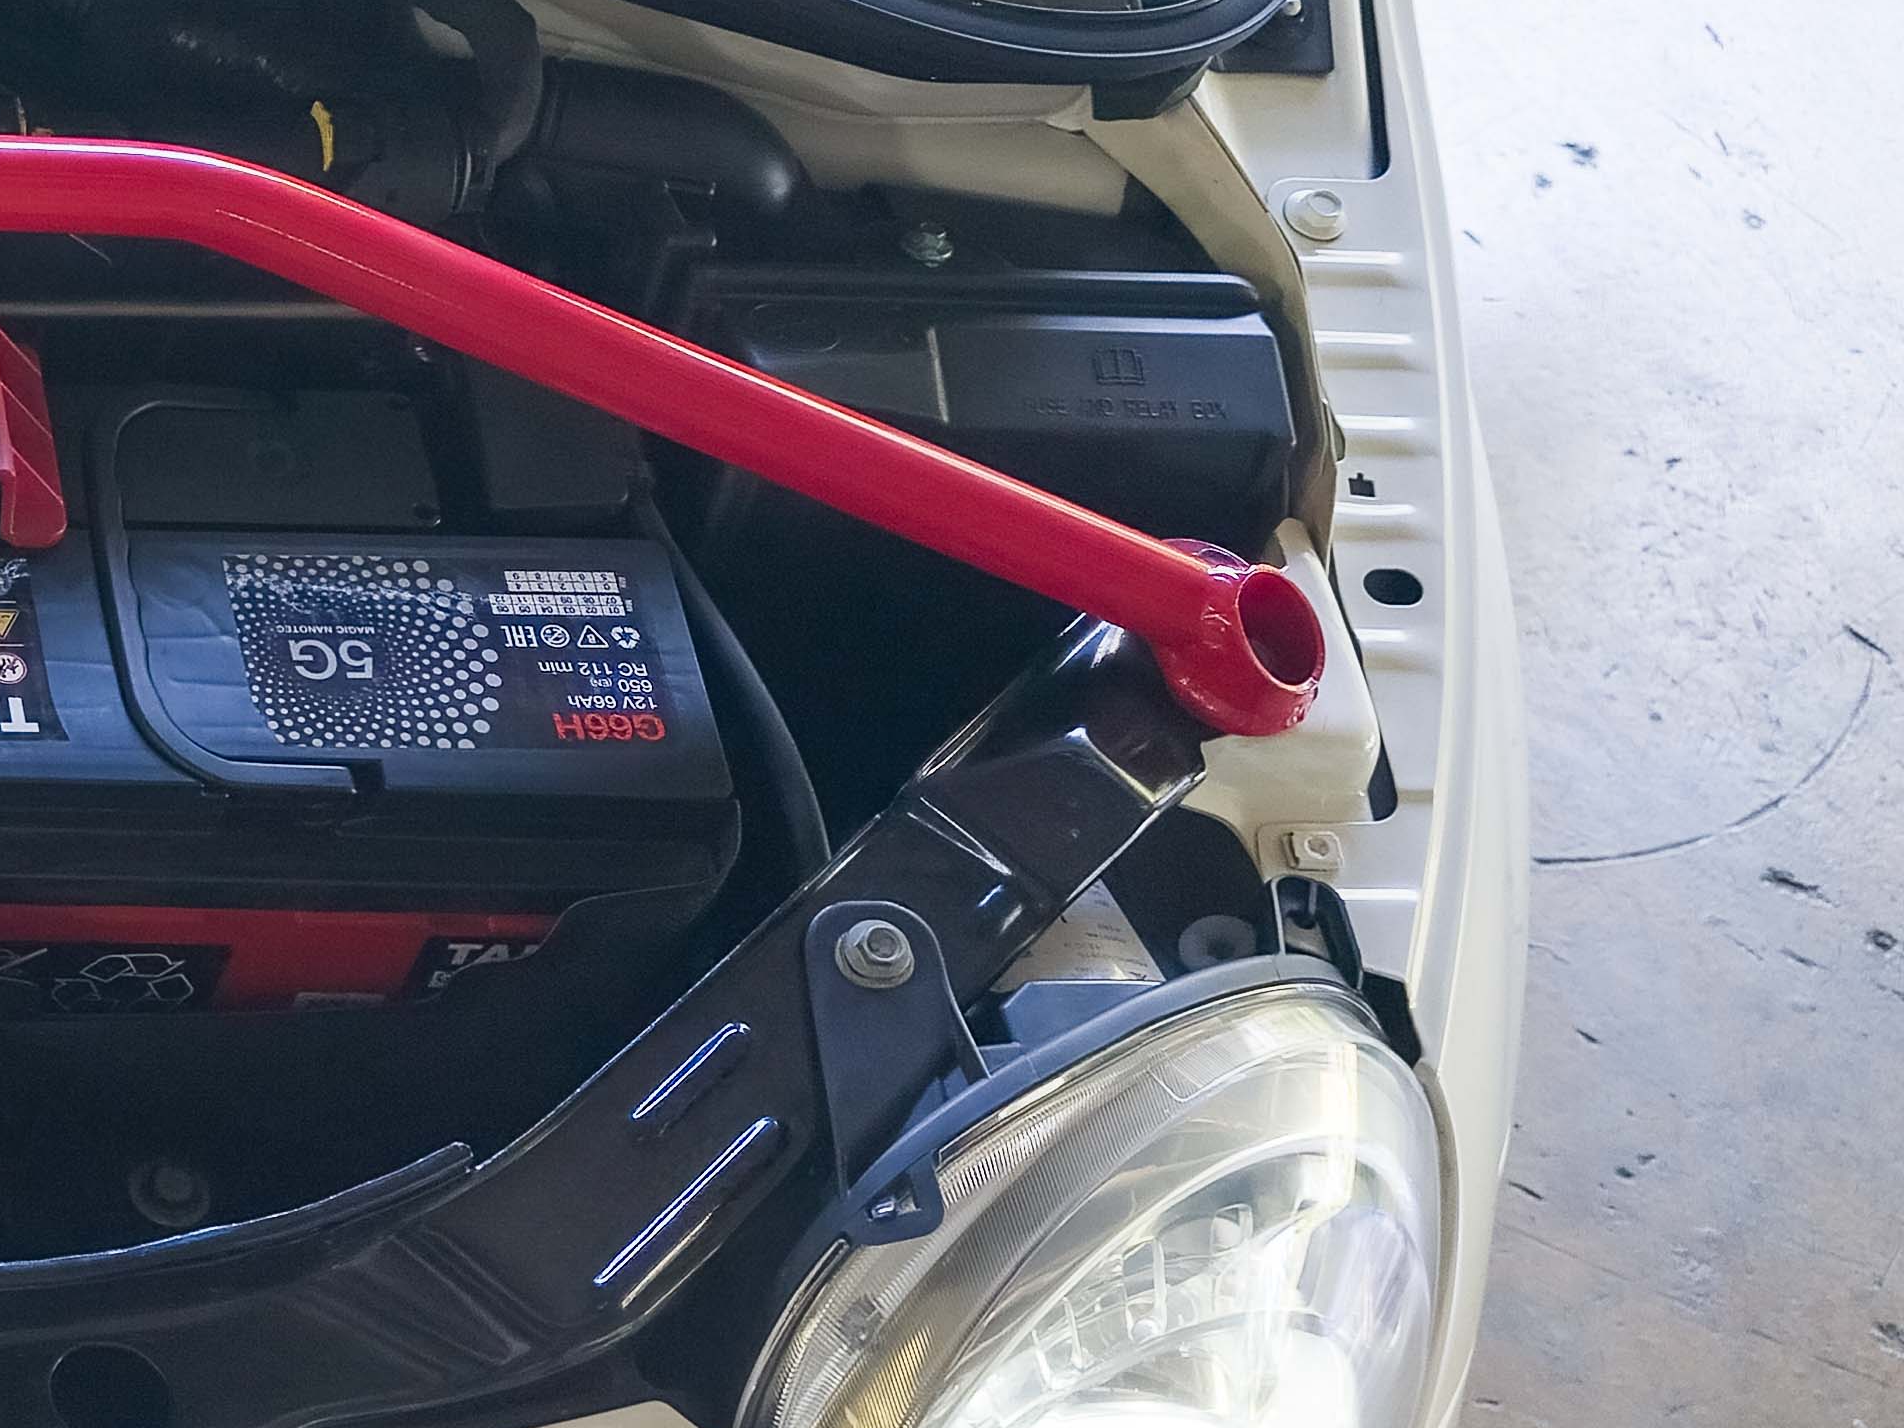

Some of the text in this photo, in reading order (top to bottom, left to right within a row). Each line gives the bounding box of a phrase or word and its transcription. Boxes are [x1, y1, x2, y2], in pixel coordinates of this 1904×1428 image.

[1188, 399, 1229, 420] BOX
[276, 625, 376, 635] MAGIC NANOTEC
[288, 639, 374, 681] 5G
[538, 661, 649, 676] RC 112 min
[589, 678, 653, 693] 650 (EN)
[567, 695, 658, 710] 12V 66Ah
[551, 713, 666, 742] G66H
